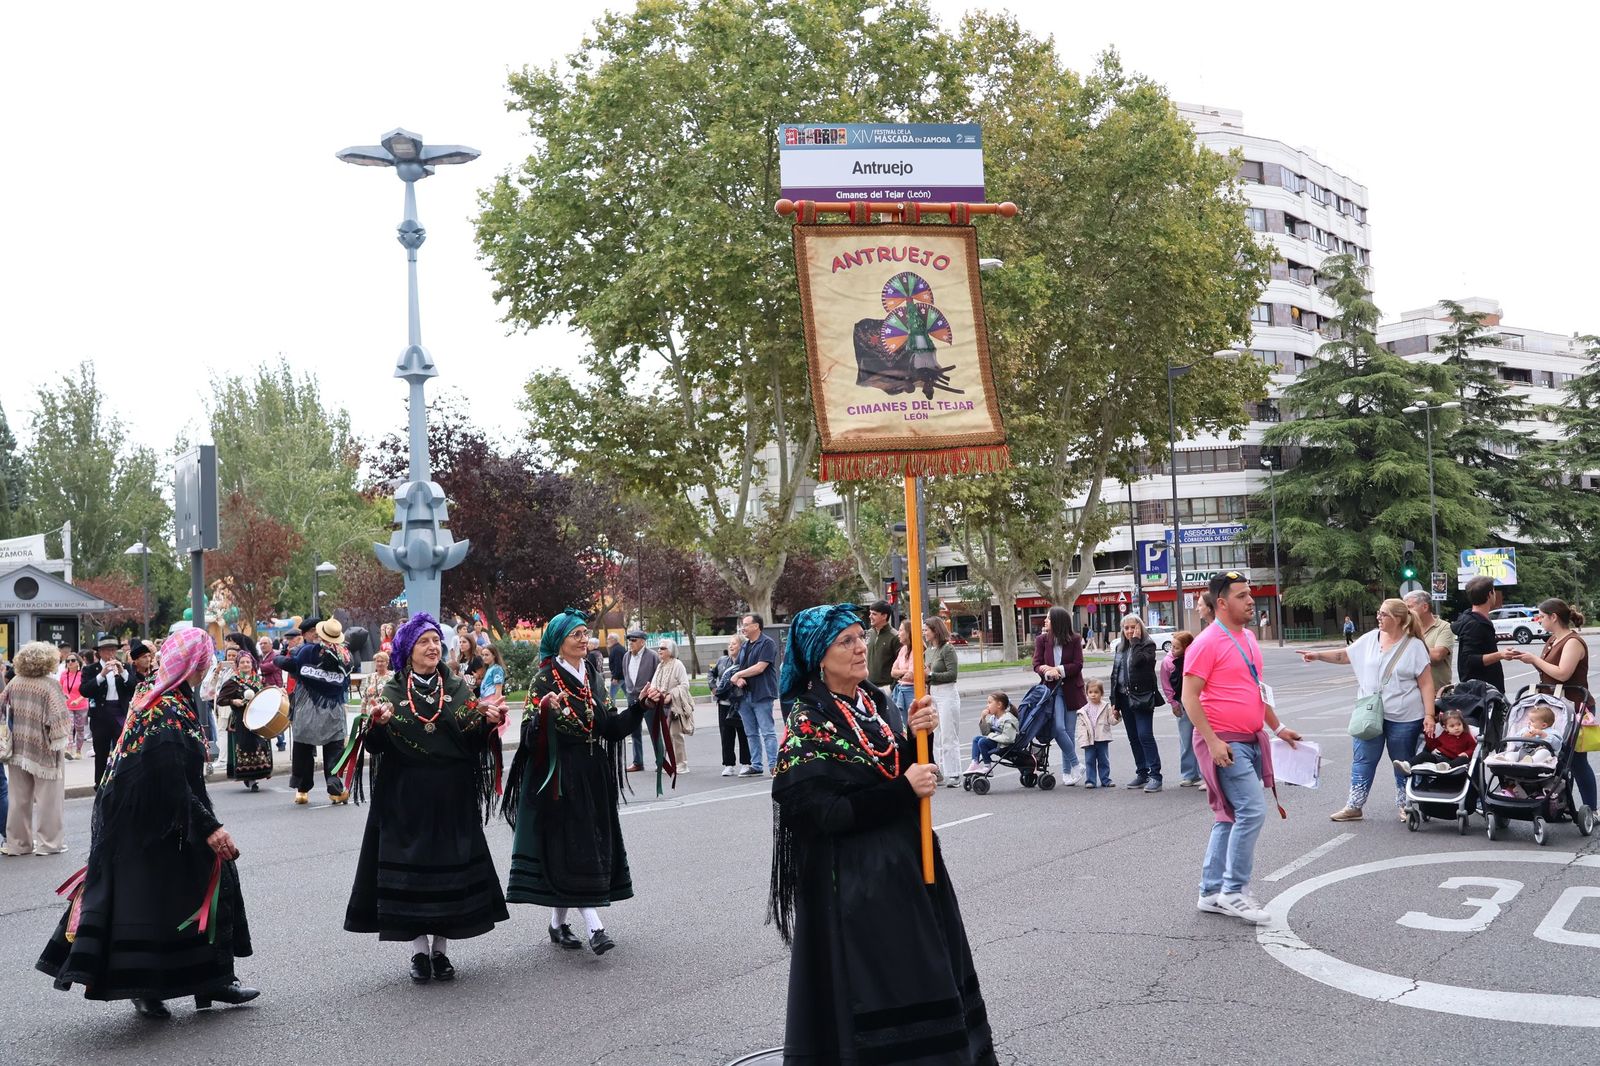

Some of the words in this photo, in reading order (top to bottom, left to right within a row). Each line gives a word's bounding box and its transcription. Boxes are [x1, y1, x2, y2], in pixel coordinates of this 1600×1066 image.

[852, 129, 874, 144] XIV
[874, 134, 914, 144] MÁSCARA
[852, 160, 913, 176] Antruejo
[835, 190, 868, 199] Cimanes
[870, 190, 882, 199] del
[885, 190, 904, 199] Tejar
[907, 190, 932, 199] (León)
[832, 246, 951, 273] ANTRUEJO
[847, 401, 908, 416] CIMANES
[912, 400, 934, 411] DEL
[937, 400, 974, 411] TEJAR
[904, 412, 929, 420] LEÓN
[1184, 528, 1216, 537] ASESORÍA
[1219, 527, 1243, 535] MIELGO
[1184, 535, 1213, 543] CORREDURÍA
[1145, 544, 1161, 572] P
